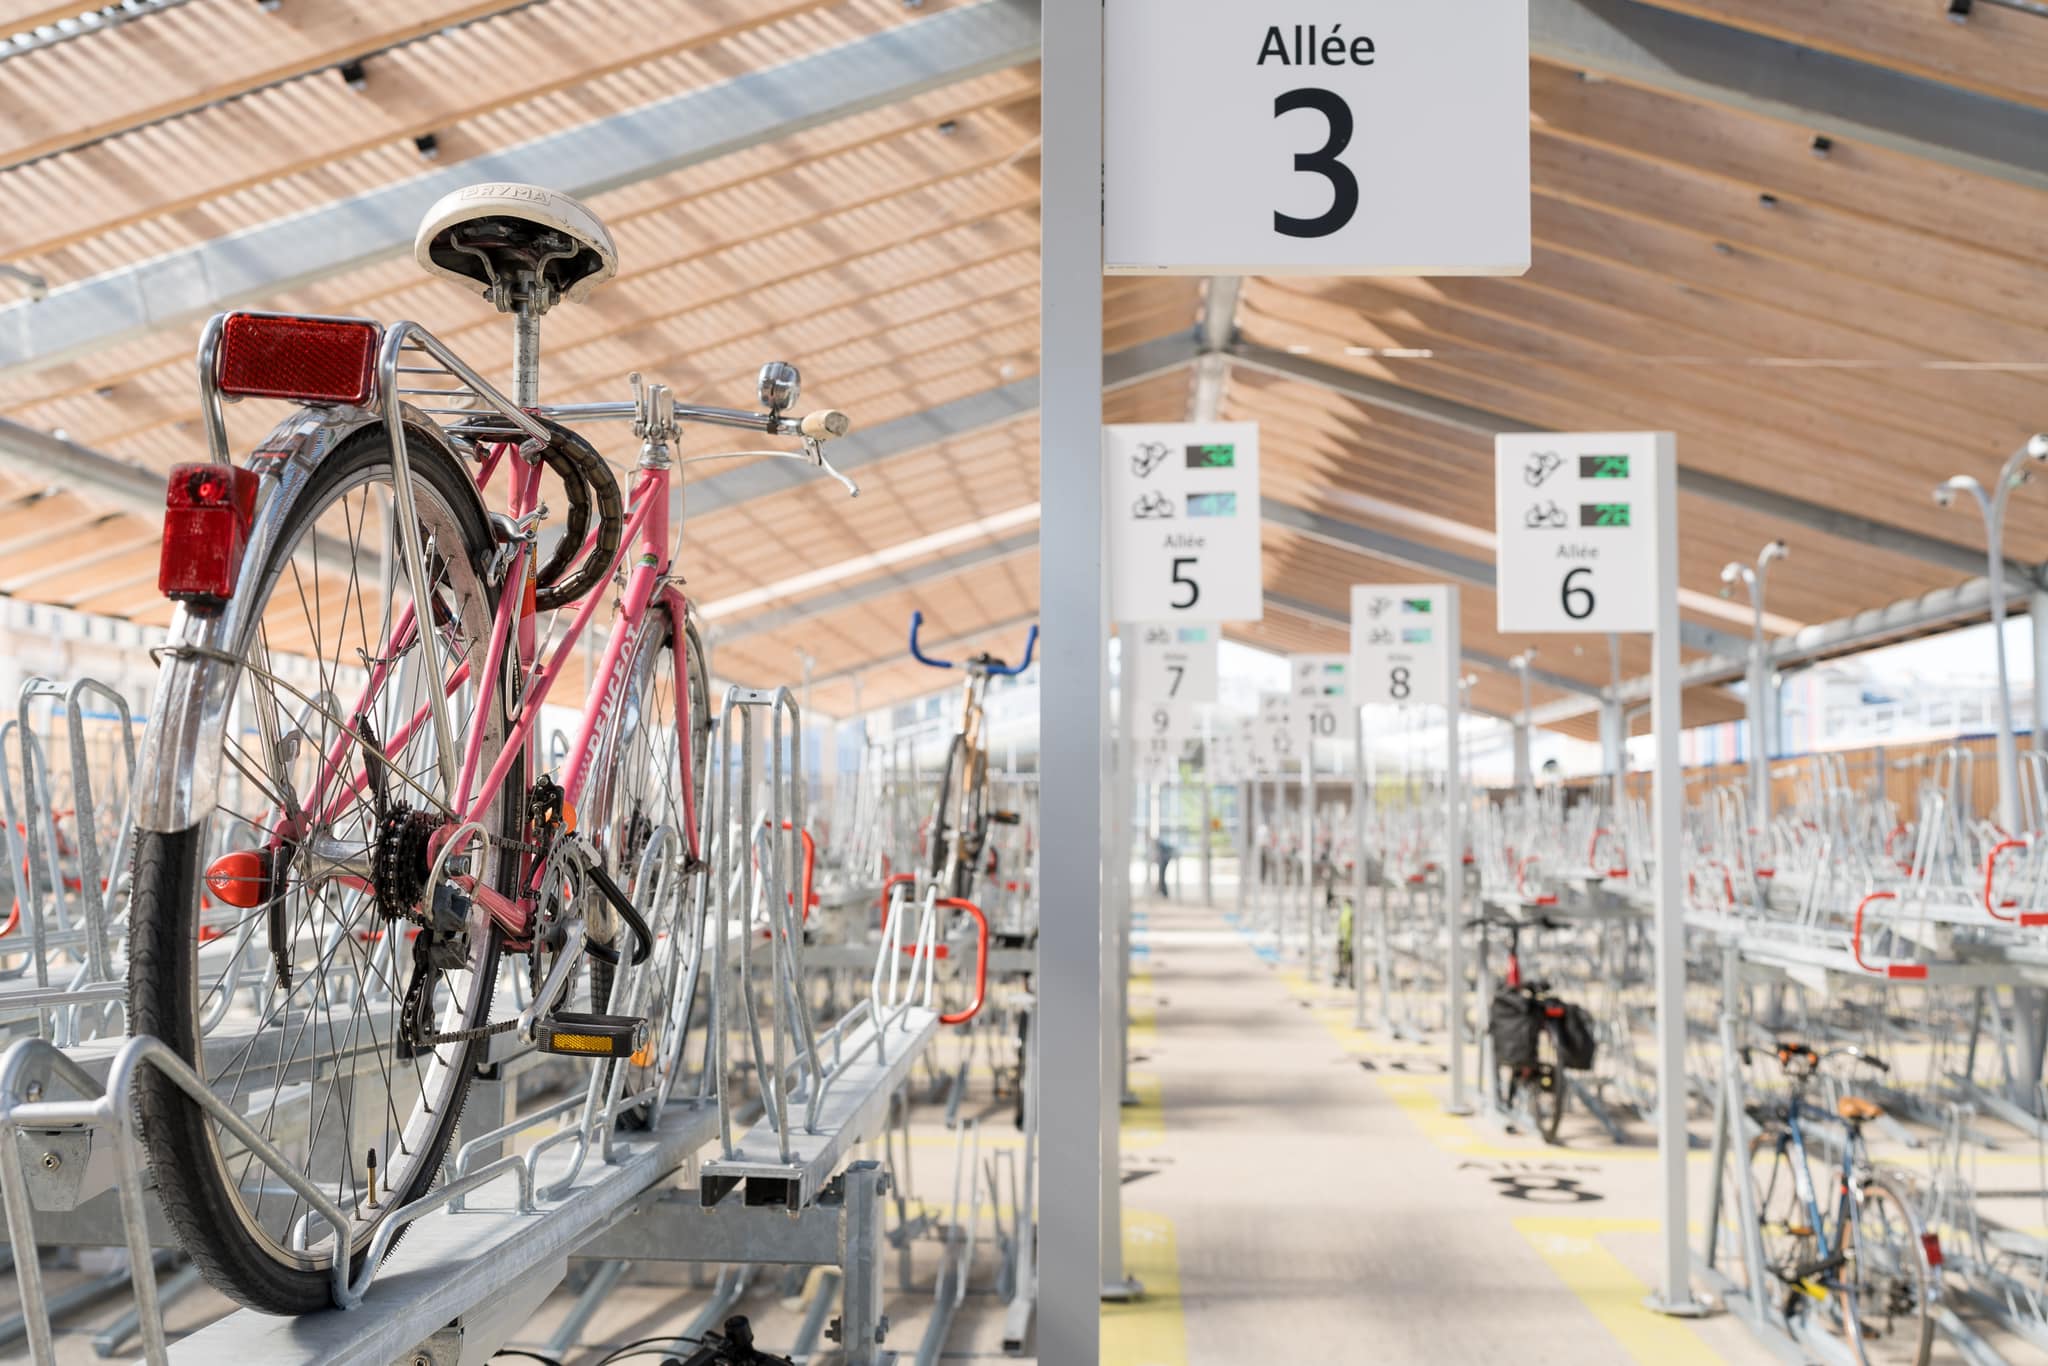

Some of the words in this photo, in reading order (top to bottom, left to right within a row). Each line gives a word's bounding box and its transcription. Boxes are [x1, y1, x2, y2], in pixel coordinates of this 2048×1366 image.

[1257, 24, 1376, 66] Allée
[1274, 87, 1360, 239] 3
[1163, 534, 1206, 549] Allée
[1556, 543, 1600, 559] Allée
[1170, 557, 1200, 610] 5
[1561, 567, 1596, 620] 6
[587, 622, 638, 757] PEUGEOT
[1167, 665, 1185, 697] 7
[1389, 666, 1411, 699] 8
[1153, 710, 1169, 733] 9
[1308, 711, 1337, 736] 10
[1490, 1176, 1606, 1203] 8
